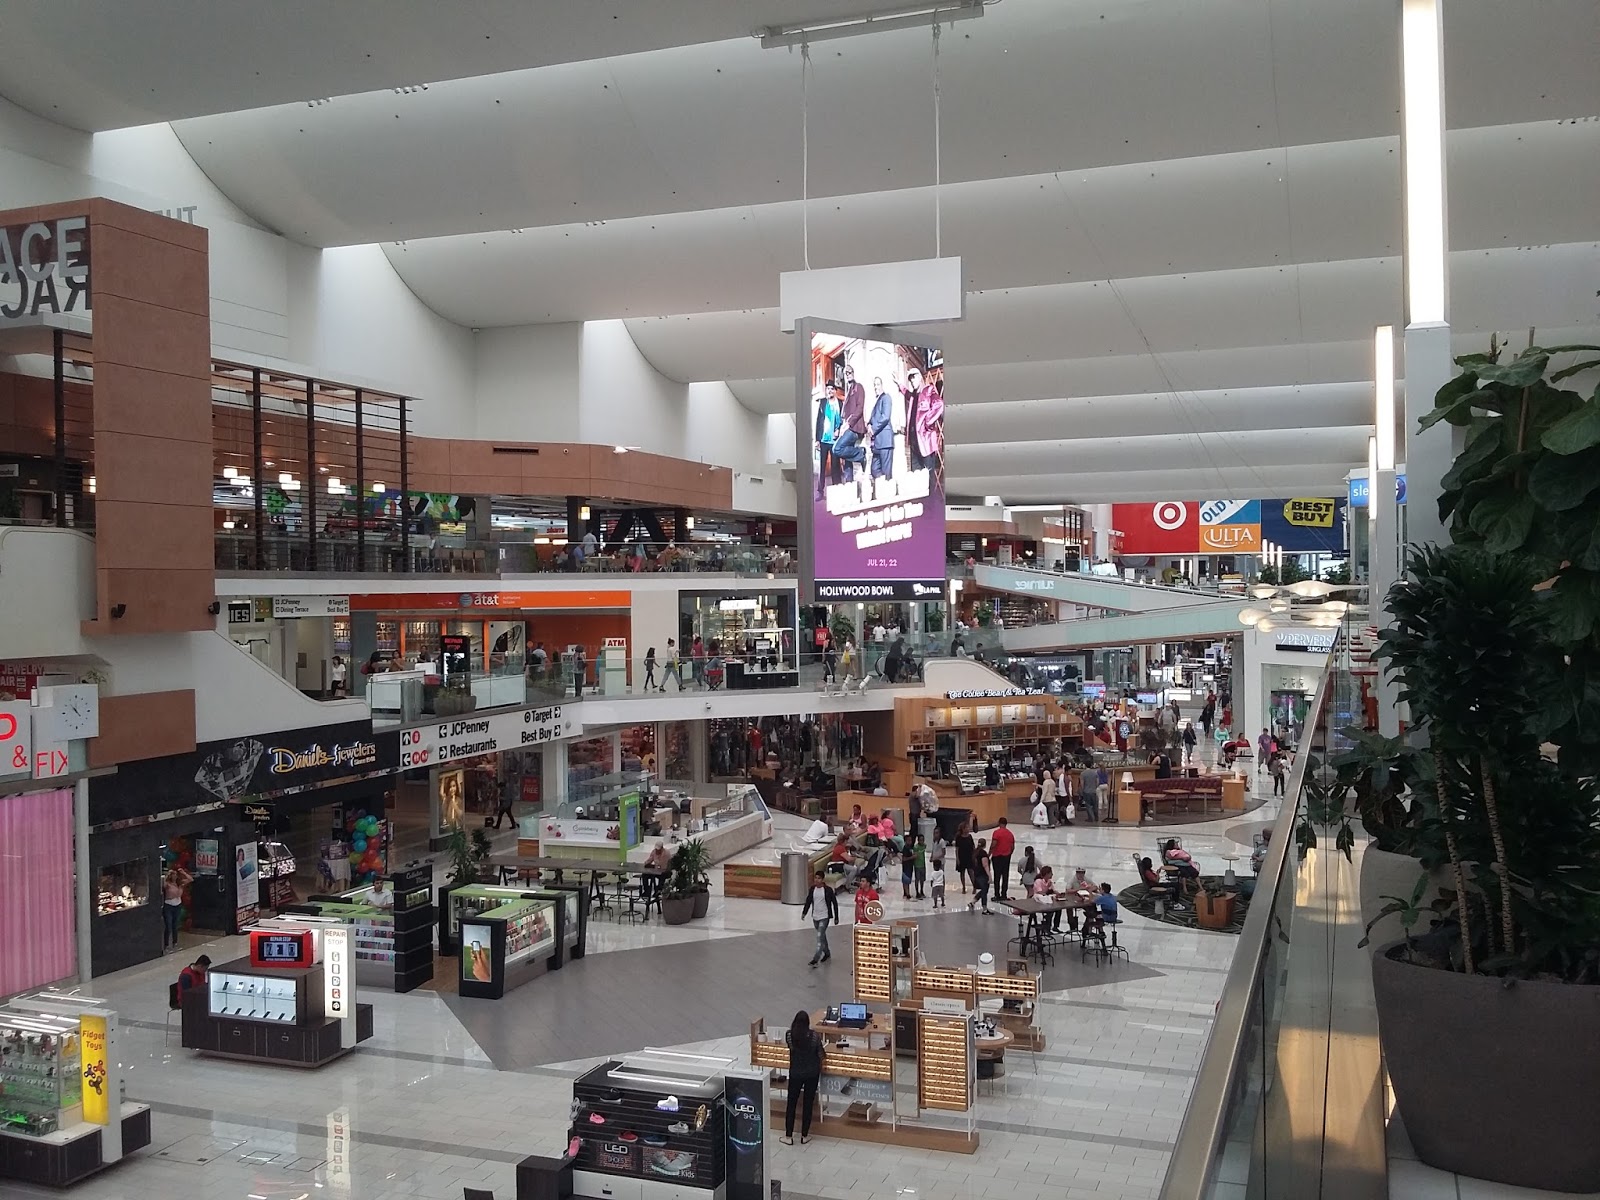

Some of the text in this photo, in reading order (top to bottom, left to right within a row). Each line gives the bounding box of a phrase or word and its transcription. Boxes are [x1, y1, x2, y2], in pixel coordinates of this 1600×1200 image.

[1353, 484, 1369, 497] sle
[1201, 501, 1227, 523] OLD
[1291, 501, 1333, 512] BEST
[1292, 511, 1329, 522] BUY
[1209, 527, 1254, 542] ULTA
[867, 559, 878, 567] JUL
[889, 559, 898, 567] 22
[819, 585, 895, 597] HOLLYWOOD BOWL
[474, 591, 500, 606] at&t
[607, 639, 625, 647] ATM
[1288, 634, 1334, 647] PERVERS
[2, 664, 45, 675] JEWELRY
[962, 689, 985, 698] Coffee
[1013, 687, 1026, 696] Tea
[1026, 686, 1046, 696] Leaf
[532, 709, 552, 723] Target
[450, 720, 490, 737] JCPenney
[521, 728, 552, 743] Best Buy
[450, 738, 497, 757] Restaurants
[13, 745, 28, 768] &
[36, 750, 68, 777] FIX
[82, 1030, 105, 1041] Fidget
[85, 1040, 103, 1051] Toys
[867, 1089, 890, 1099] Lenses
[734, 1103, 755, 1113] LED
[743, 1112, 762, 1121] SHOES
[604, 1143, 629, 1155] LED
[680, 1168, 695, 1179] Kids
